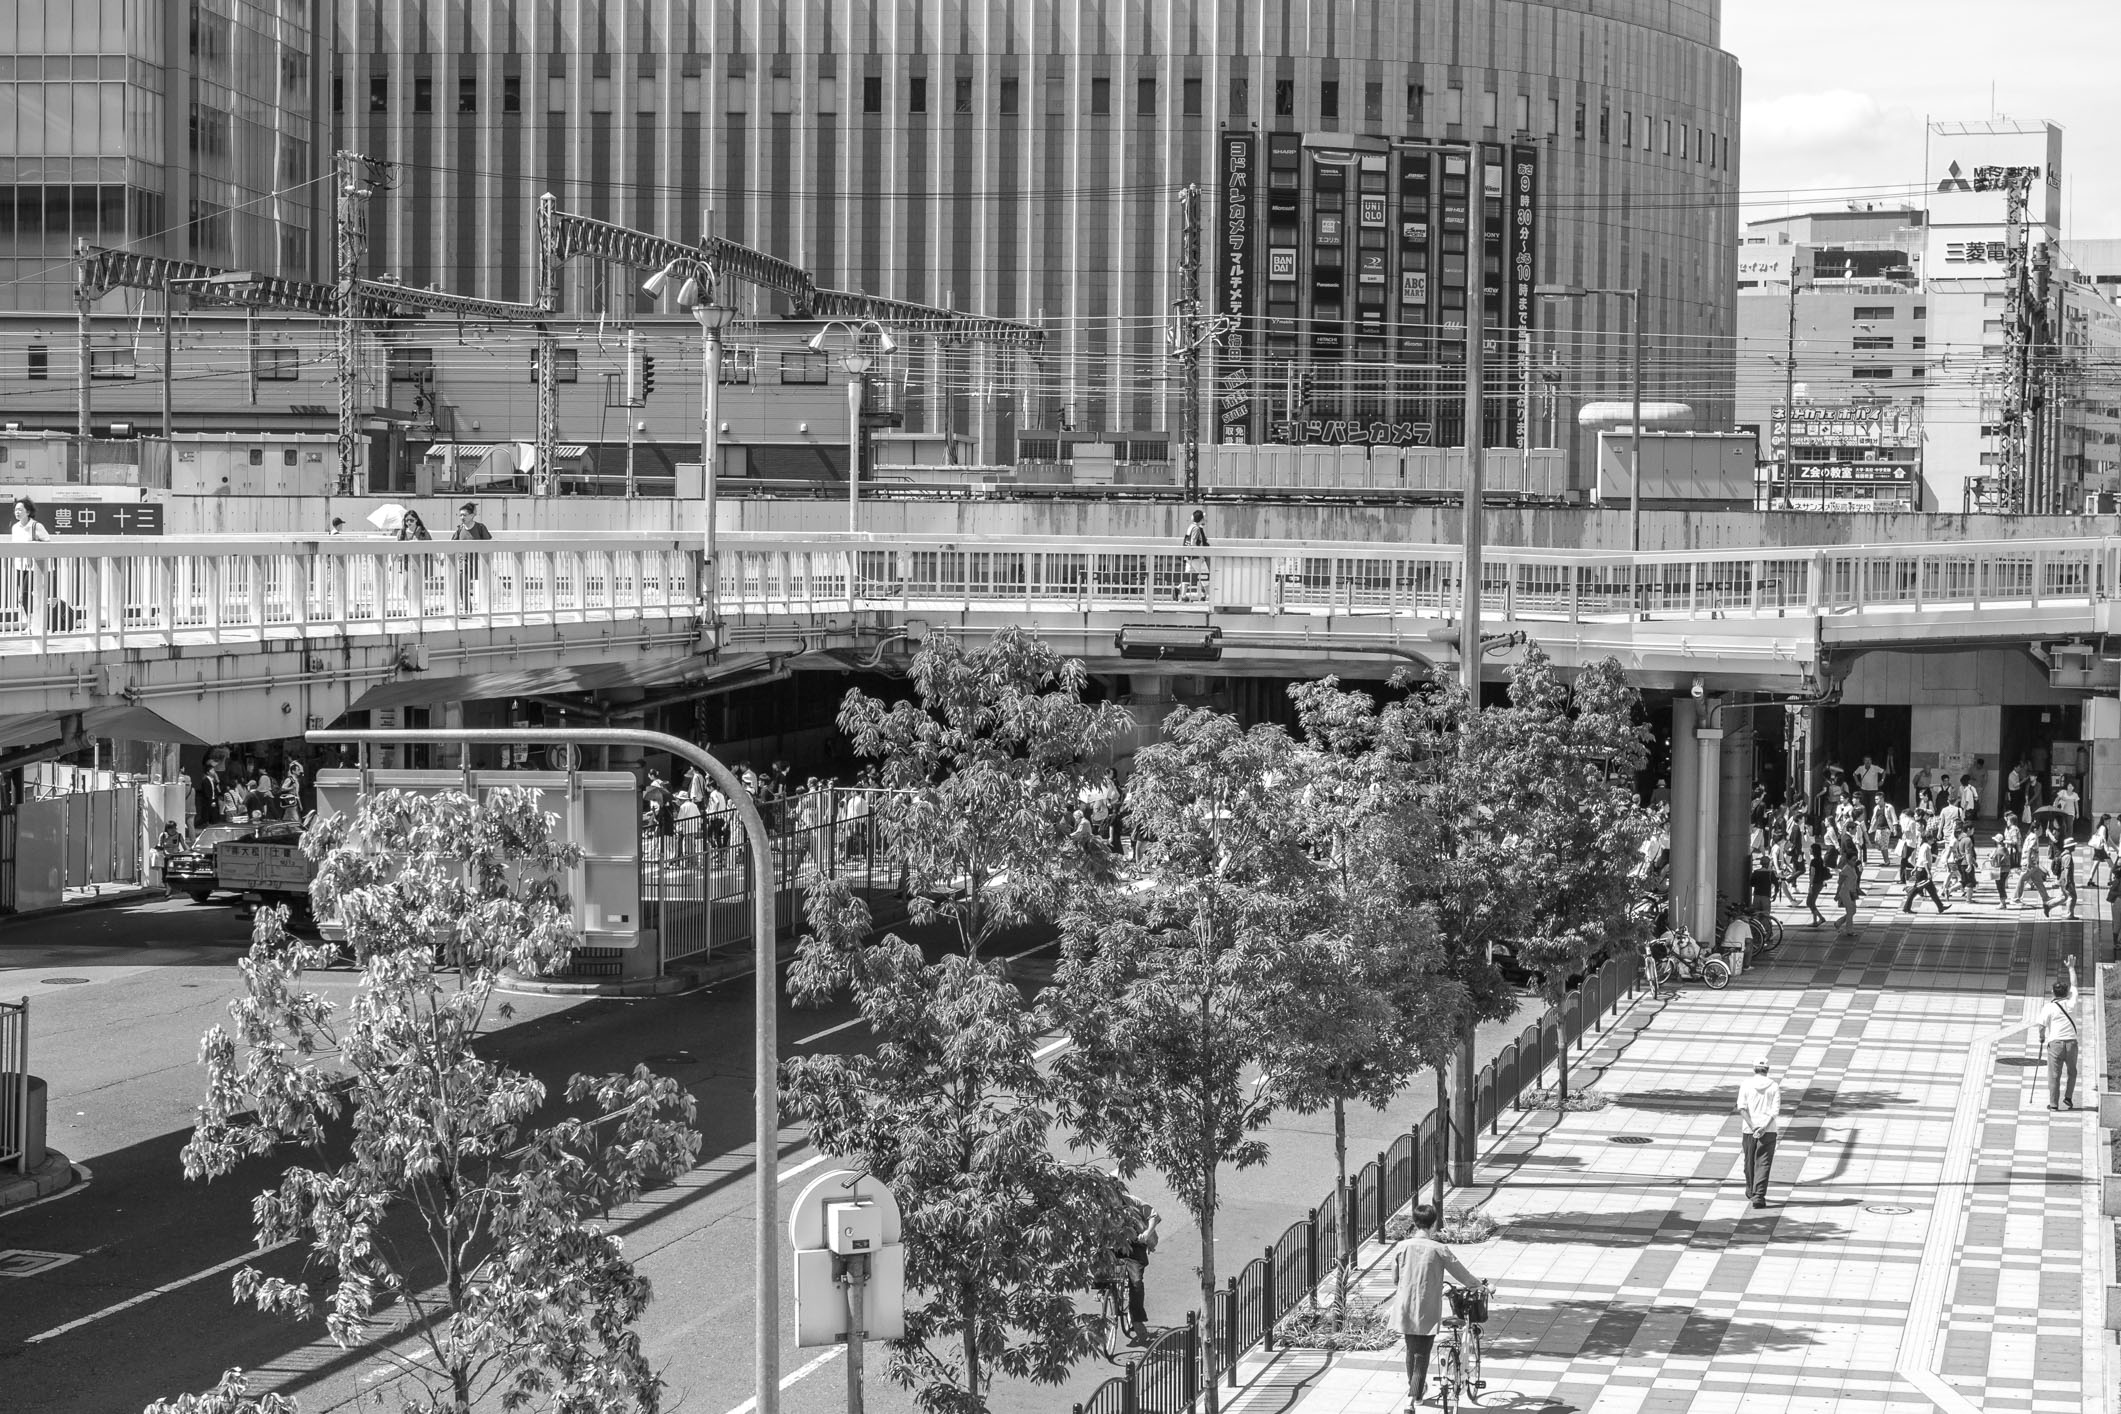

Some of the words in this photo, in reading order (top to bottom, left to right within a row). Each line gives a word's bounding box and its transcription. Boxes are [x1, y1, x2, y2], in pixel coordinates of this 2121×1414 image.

[1365, 202, 1381, 211] UNI
[1365, 211, 1382, 221] QLO
[1273, 257, 1292, 265] BAN
[1404, 278, 1425, 289] ABC
[1404, 289, 1425, 297] MART
[1222, 404, 1248, 424] STORE
[1838, 407, 1882, 421] ポパイ
[1801, 467, 1852, 479] Z会の教室
[55, 508, 95, 528] 豊中
[113, 508, 155, 528] 十三
